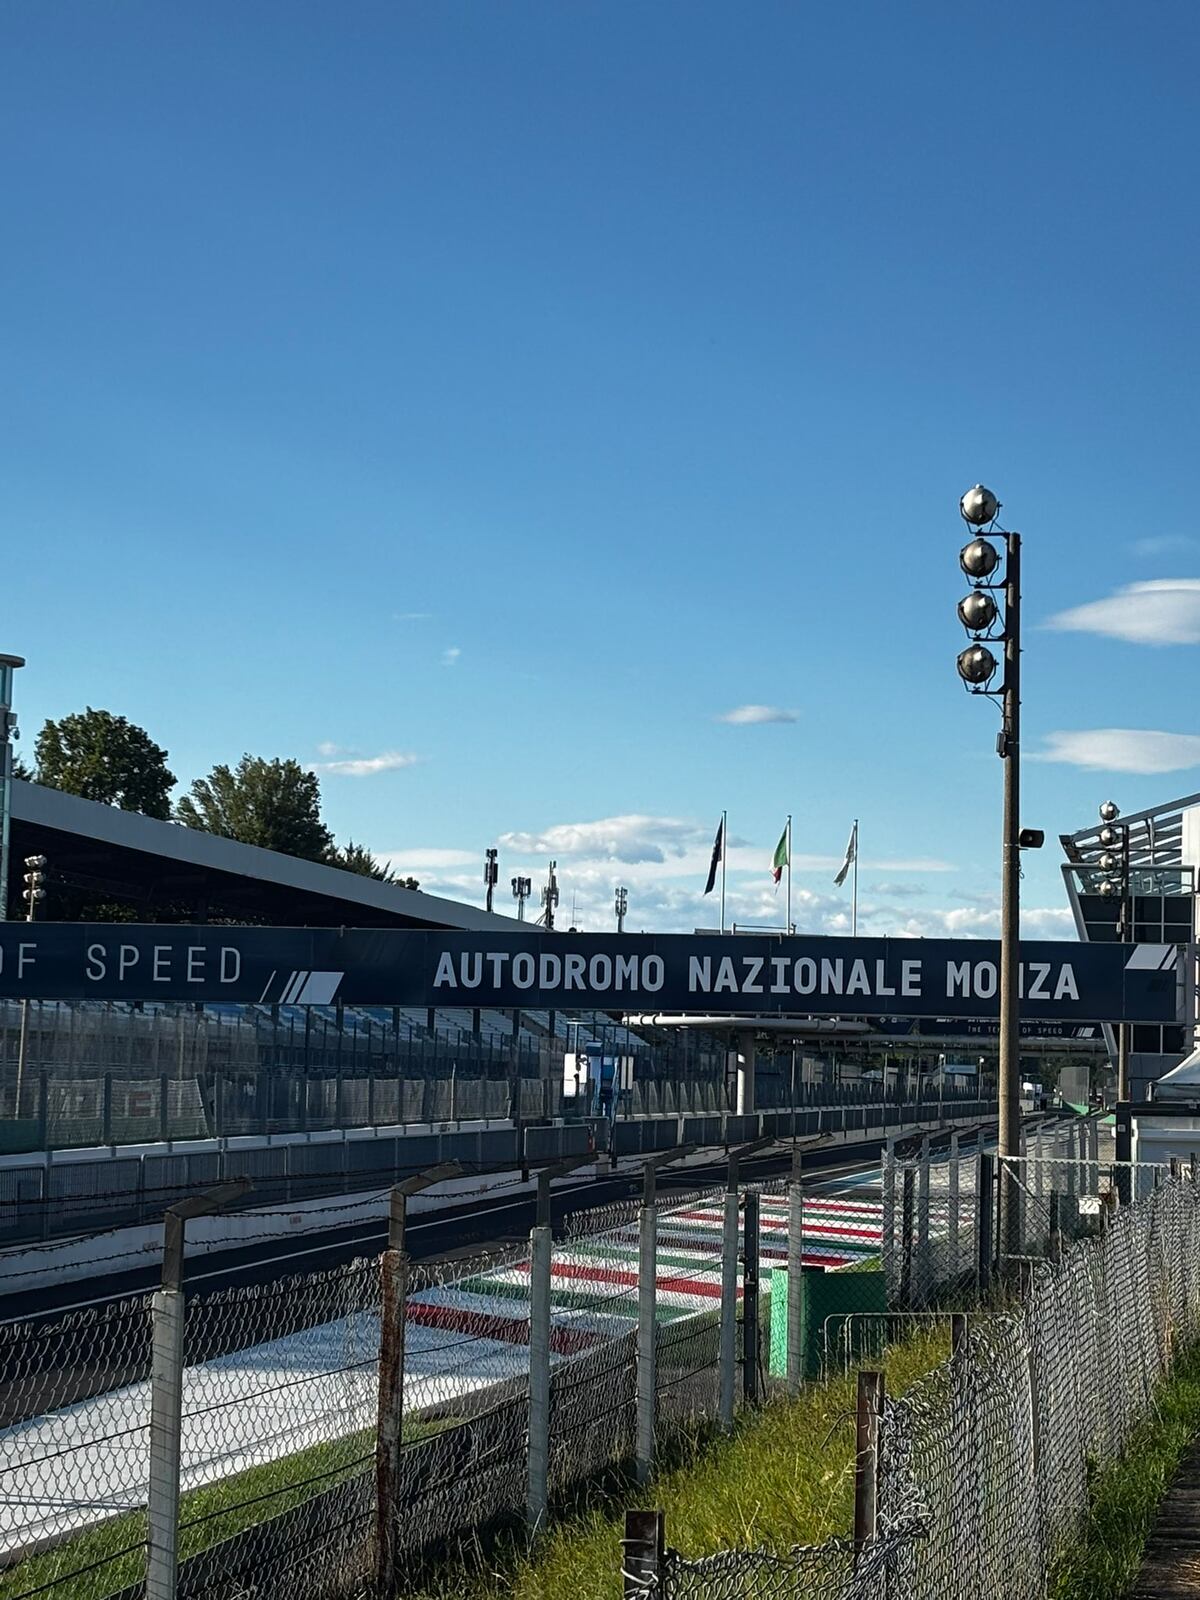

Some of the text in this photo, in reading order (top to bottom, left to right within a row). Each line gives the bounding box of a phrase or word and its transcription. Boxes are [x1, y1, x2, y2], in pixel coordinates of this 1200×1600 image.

[0, 943, 241, 983] F SPEED
[433, 952, 1080, 1000] AUTODROMO NAZIONALE MOZA
[1037, 1027, 1063, 1035] SPEED
